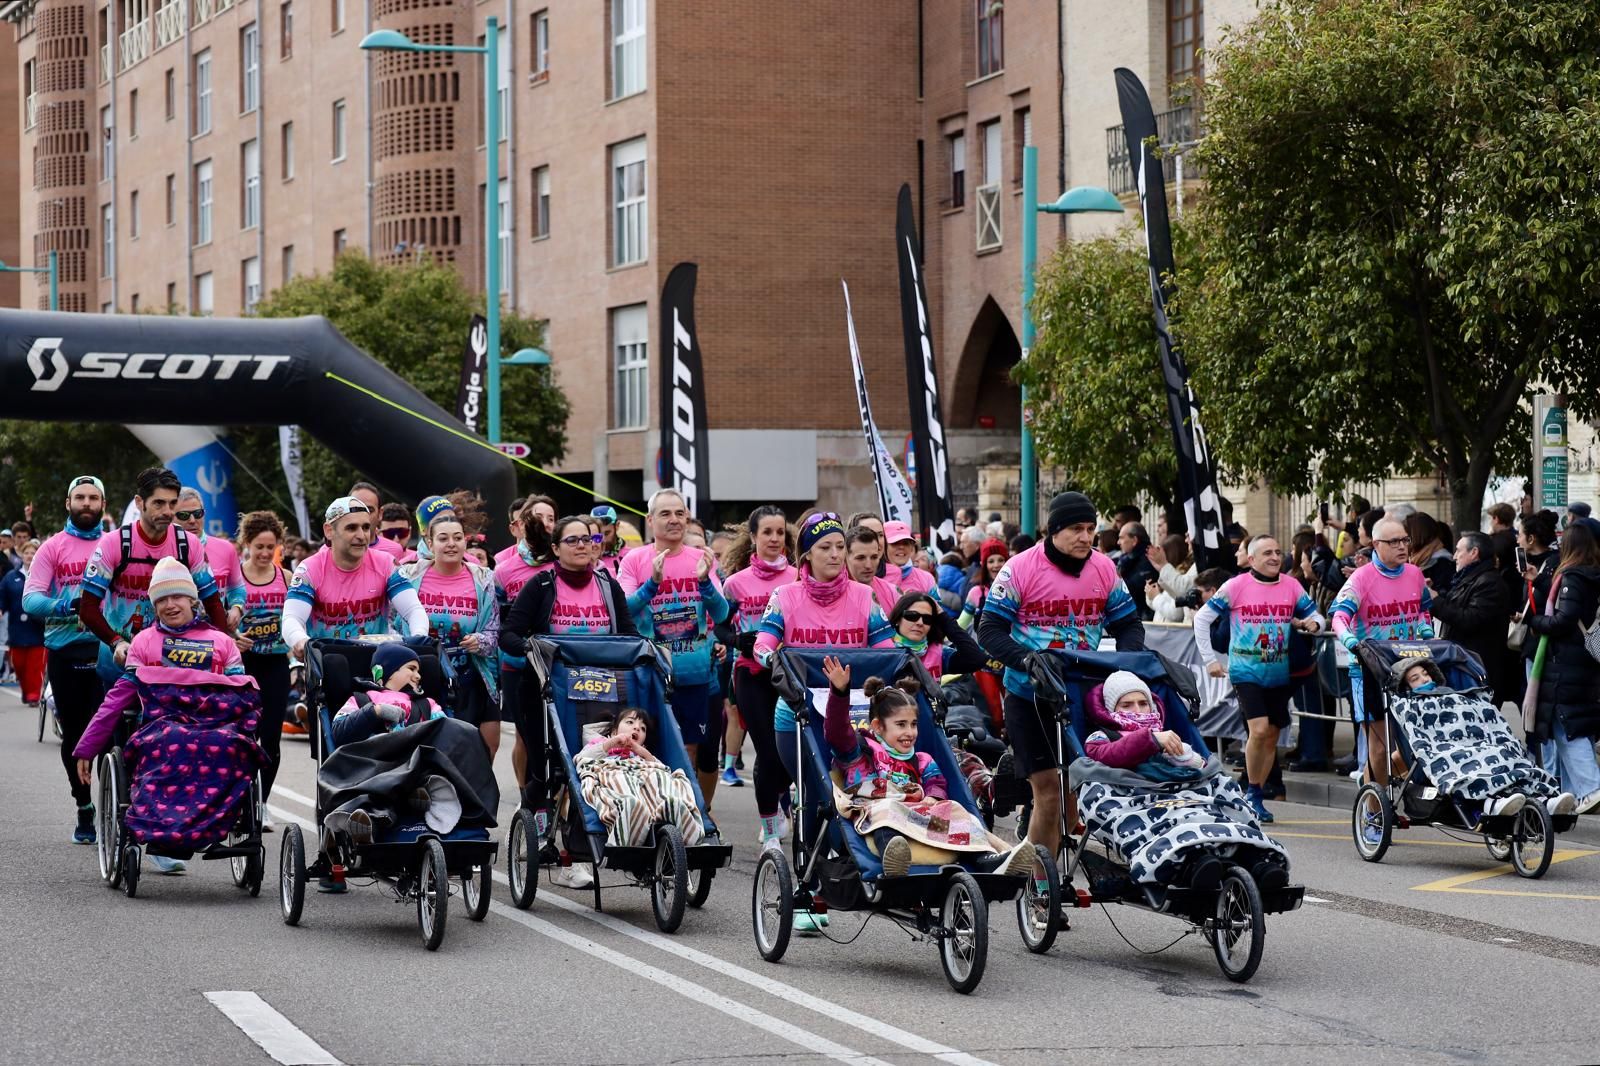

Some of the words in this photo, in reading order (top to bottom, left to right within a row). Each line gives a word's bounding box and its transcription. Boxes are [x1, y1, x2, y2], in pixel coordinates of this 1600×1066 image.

[72, 352, 291, 380] SCOTT
[463, 372, 483, 433] rCaja
[249, 622, 278, 636] 4808
[168, 648, 207, 664] 4727
[985, 658, 1004, 670] 467
[573, 680, 612, 693] 4657
